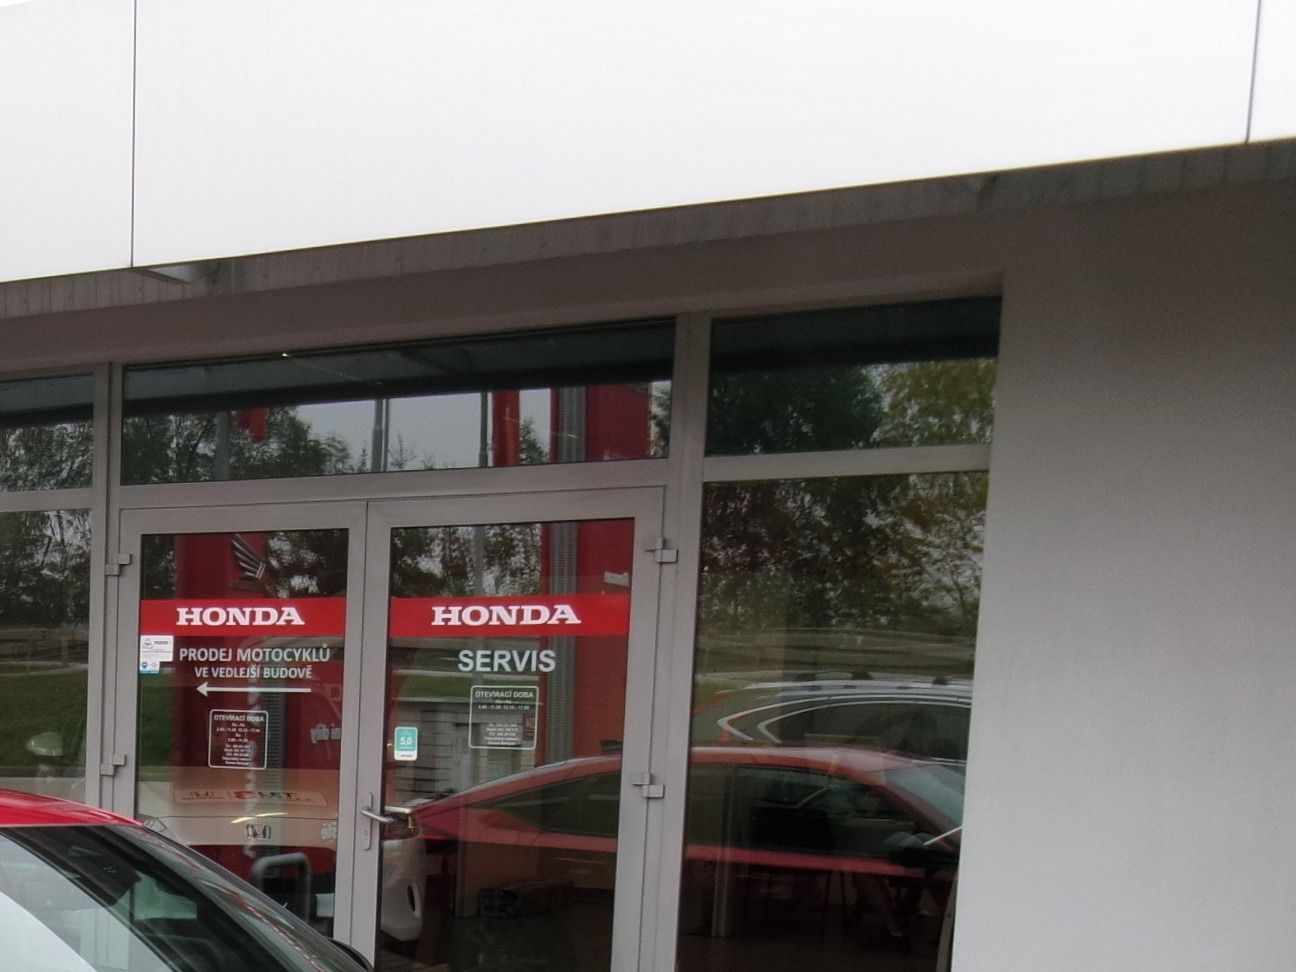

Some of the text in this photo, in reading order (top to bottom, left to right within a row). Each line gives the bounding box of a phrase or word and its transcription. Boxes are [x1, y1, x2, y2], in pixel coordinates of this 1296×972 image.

[176, 607, 305, 626] HONDA
[431, 604, 582, 626] HONDA
[179, 643, 331, 663] PRODEJ MOTOCYKLŮ
[458, 649, 556, 673] SERVIS
[194, 664, 313, 679] VE VEDLEJŠÍ BUDOVĚ
